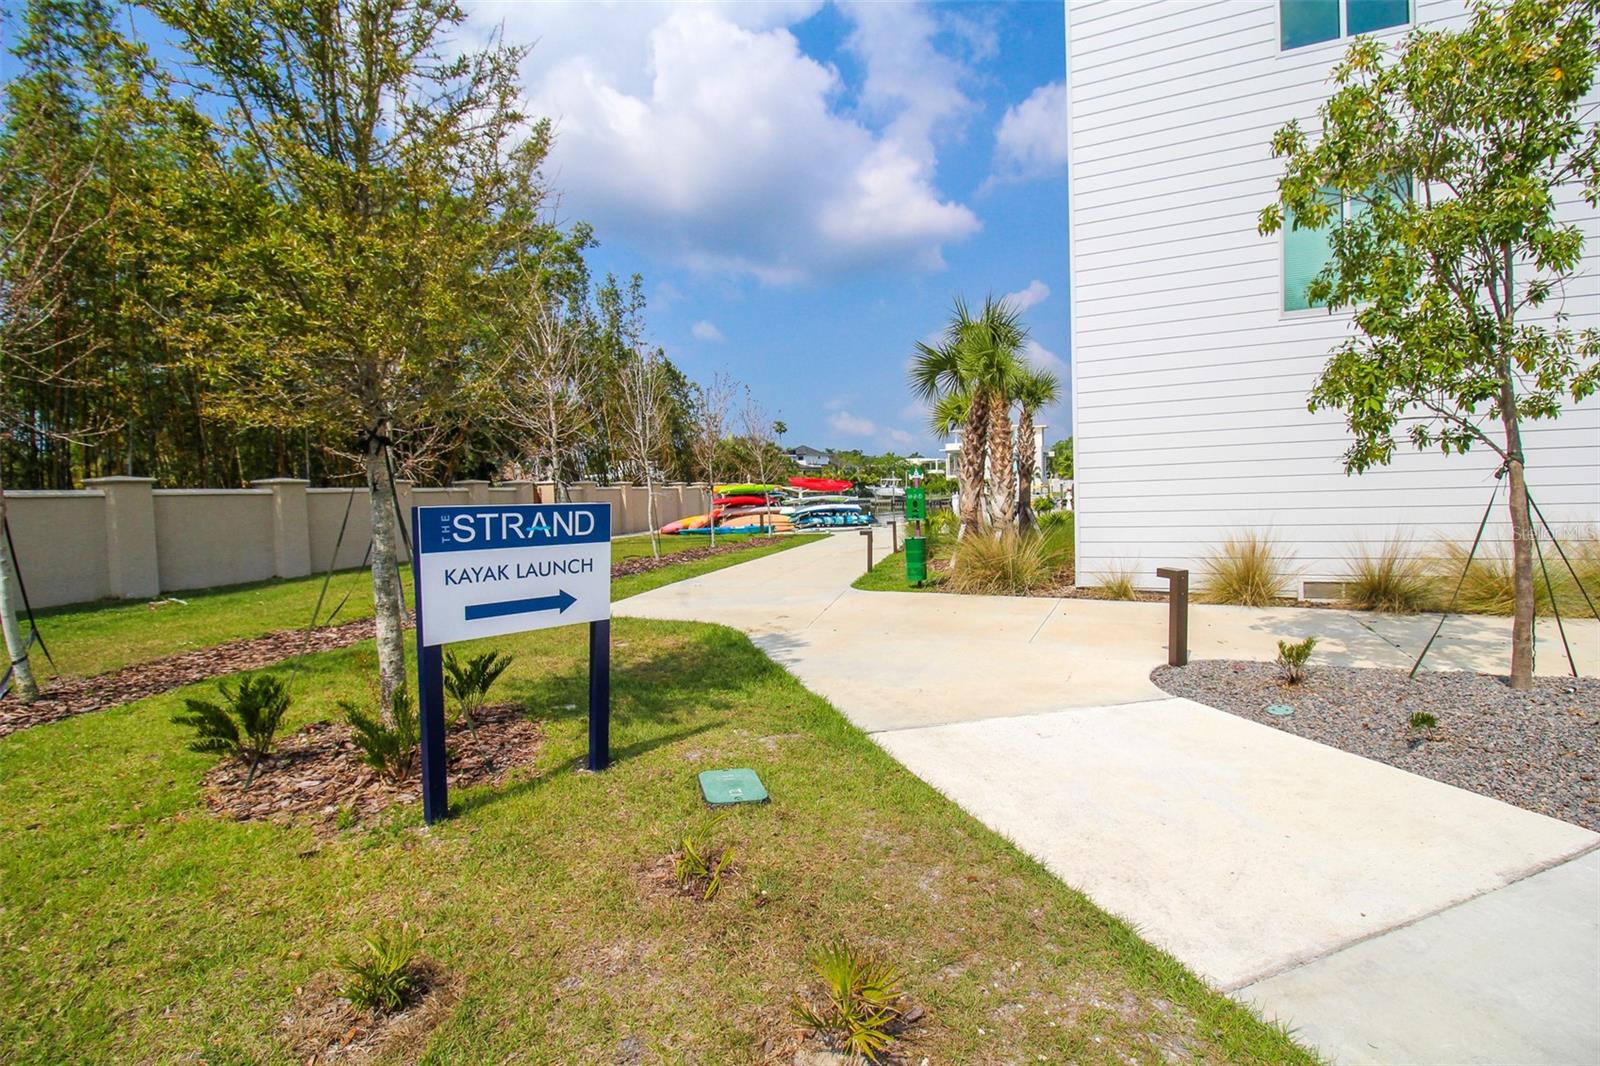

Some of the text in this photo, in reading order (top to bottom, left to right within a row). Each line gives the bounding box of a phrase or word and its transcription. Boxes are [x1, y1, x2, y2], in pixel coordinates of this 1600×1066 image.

[441, 514, 450, 543] THE
[452, 511, 595, 543] STRAND
[444, 558, 593, 586] KAYAK LAUNCH
